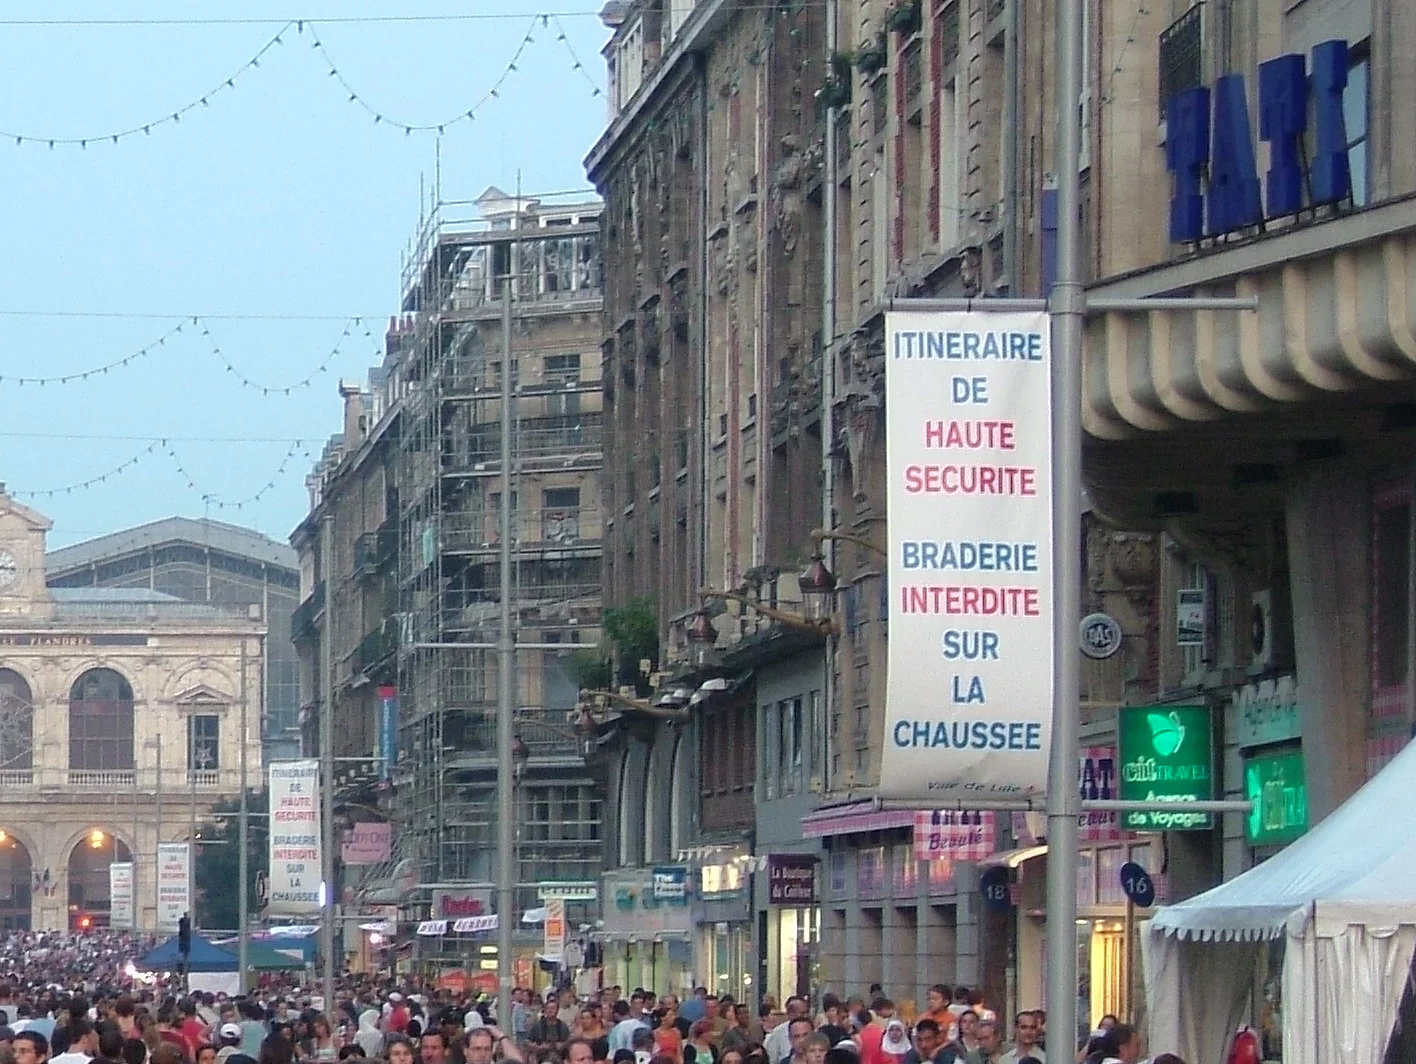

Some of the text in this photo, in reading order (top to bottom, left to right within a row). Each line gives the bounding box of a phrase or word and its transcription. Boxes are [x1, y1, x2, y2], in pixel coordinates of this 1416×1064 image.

[894, 331, 1043, 362] ITINERAIRE
[951, 376, 989, 404] DE
[925, 421, 1016, 450] HAUTE
[905, 466, 1036, 496] SECURITE
[902, 541, 1038, 572] BRADERIE
[901, 586, 1040, 617] INTERDITE
[943, 630, 999, 660] SUR
[952, 674, 986, 705] LA
[893, 719, 1042, 750] CHAUSSEE
[1150, 811, 1207, 828] Voyages
[928, 829, 983, 850] Beauté
[987, 885, 1005, 900] 18
[1127, 875, 1147, 895] 16
